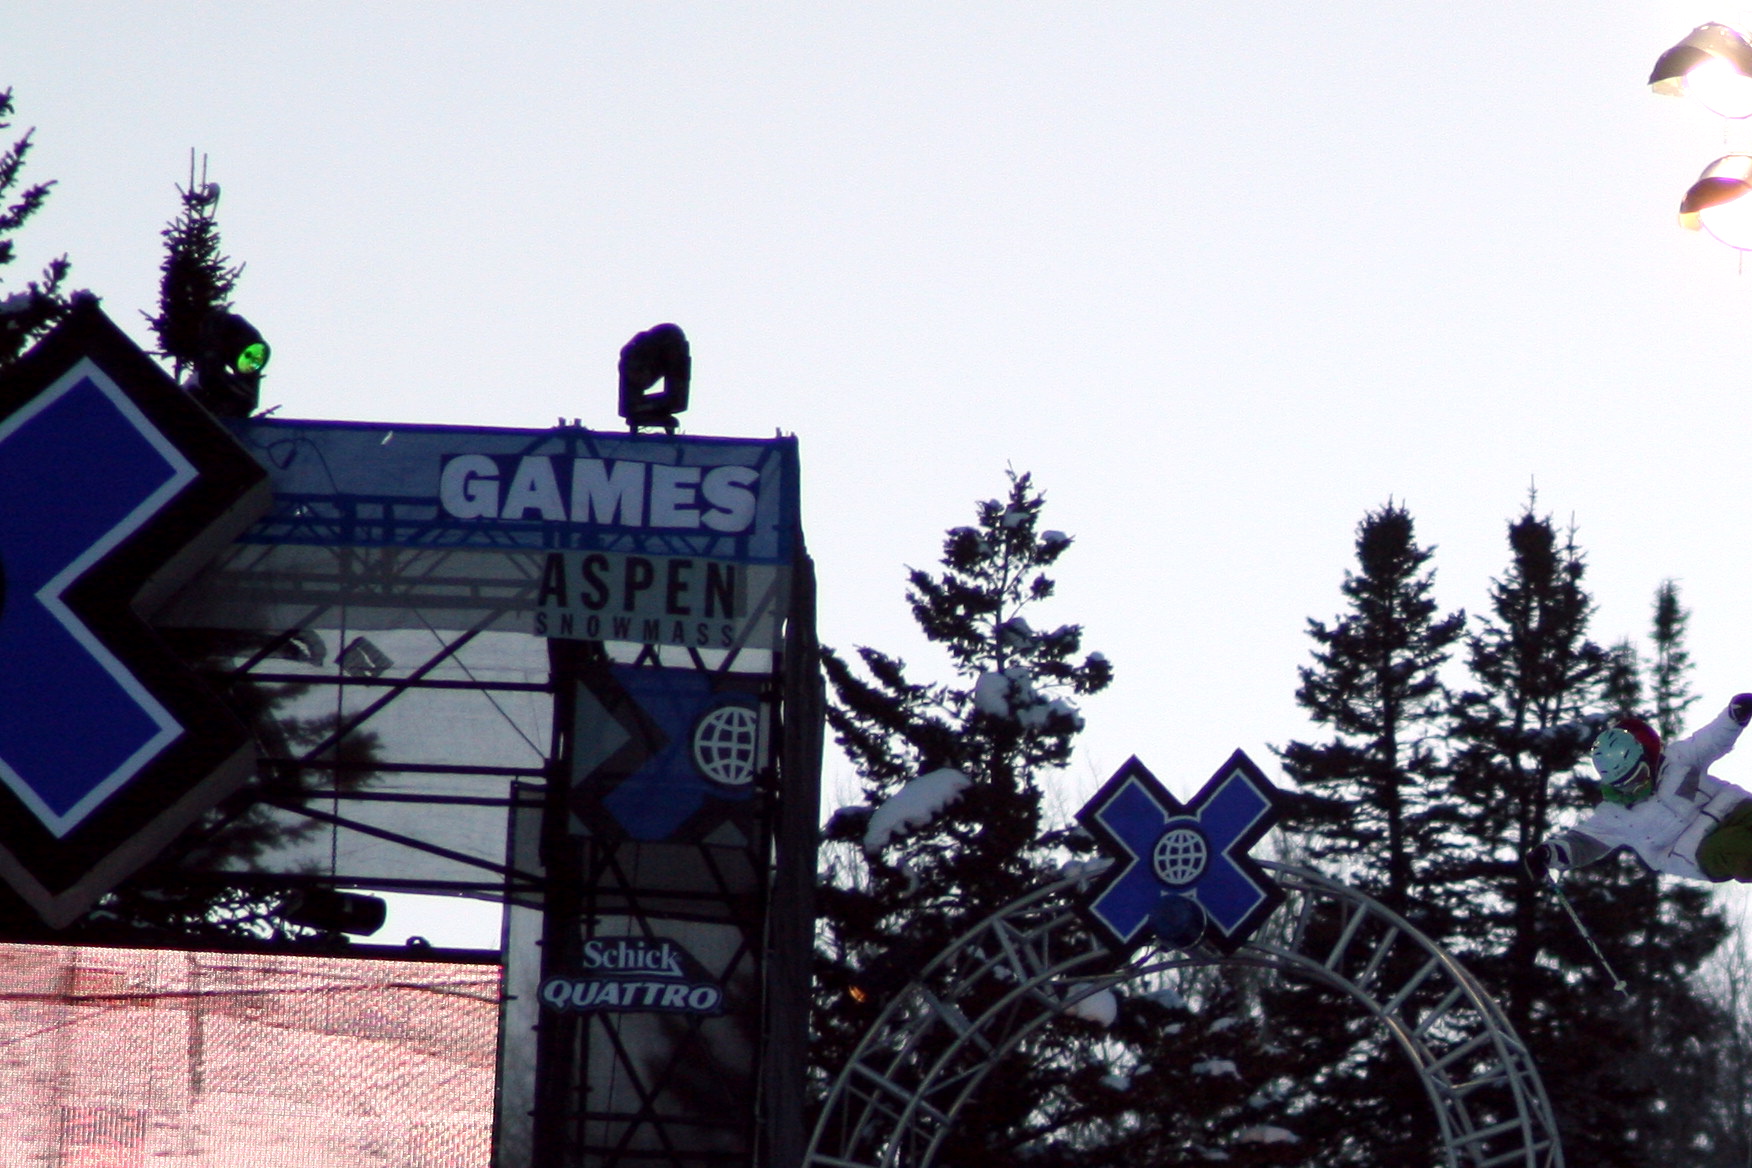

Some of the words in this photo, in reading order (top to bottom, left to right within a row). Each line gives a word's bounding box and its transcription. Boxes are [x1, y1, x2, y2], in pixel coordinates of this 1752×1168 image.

[440, 454, 760, 533] GAMES
[538, 552, 735, 619] ASPEN
[535, 611, 734, 648] SNOWMASS
[583, 939, 682, 974] Schick
[543, 978, 718, 1009] QUATTRO
